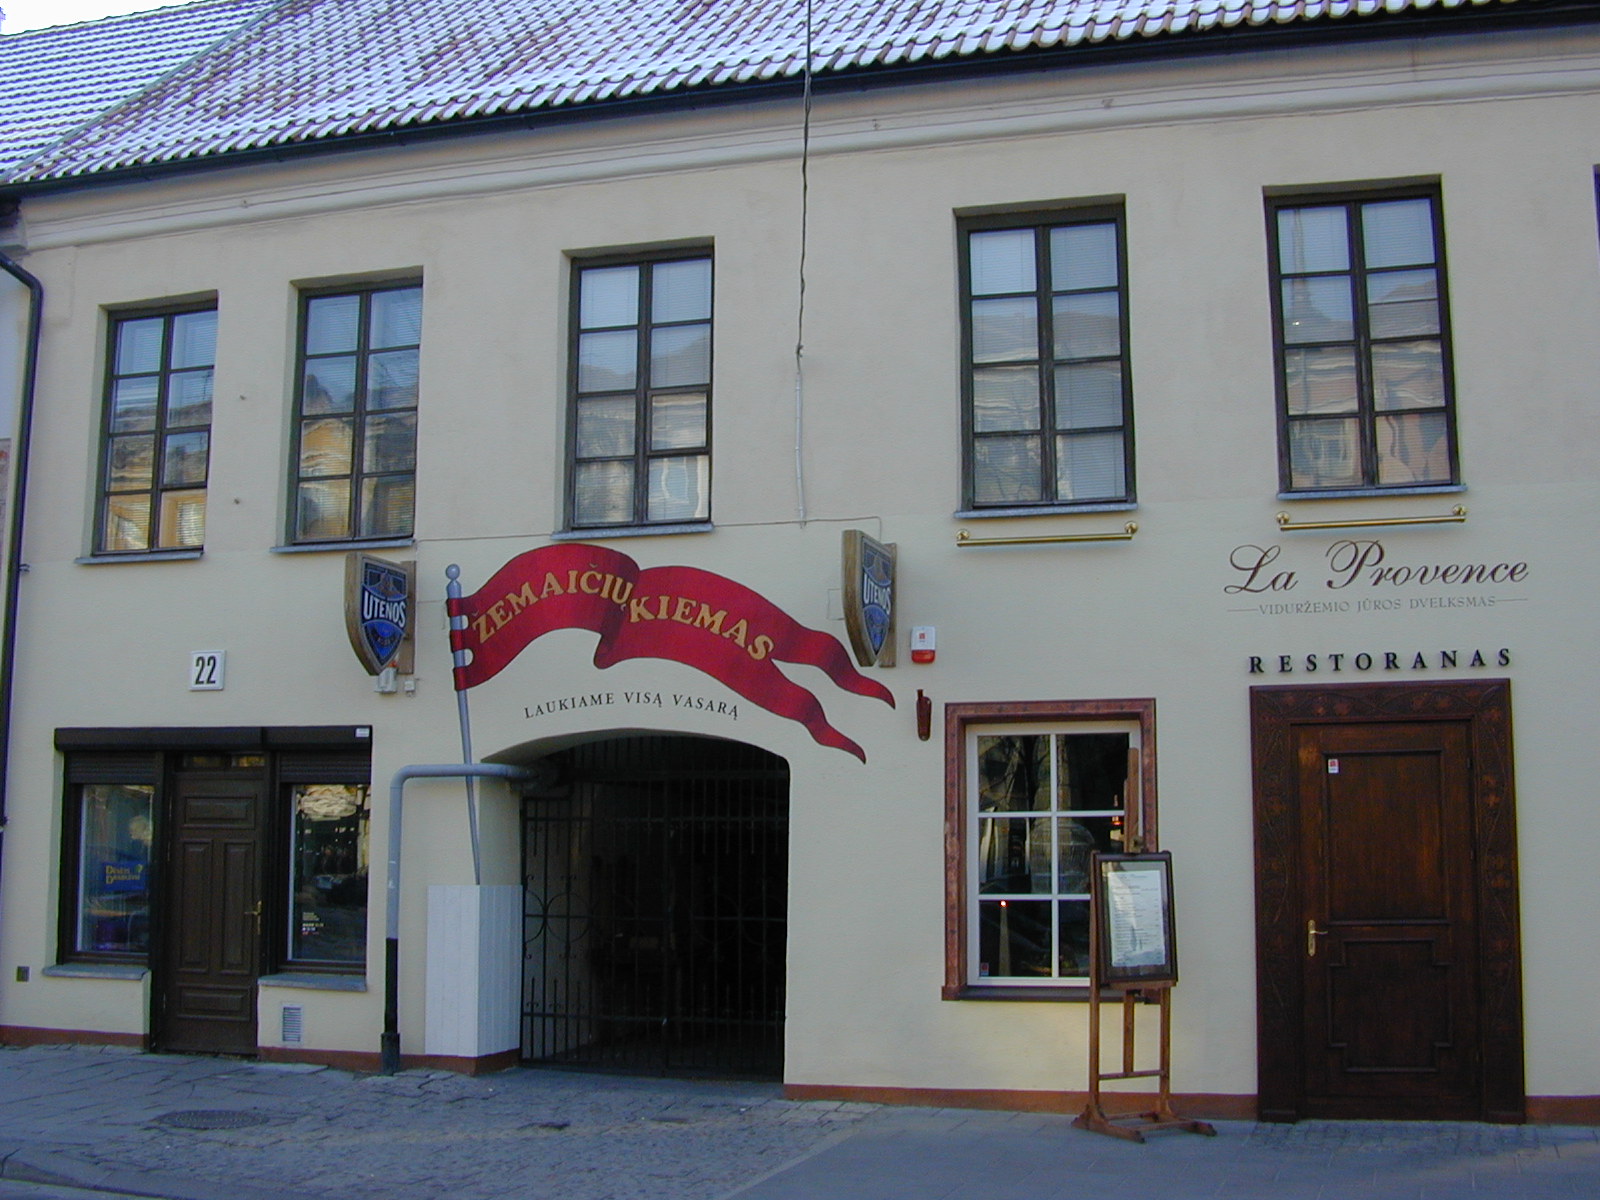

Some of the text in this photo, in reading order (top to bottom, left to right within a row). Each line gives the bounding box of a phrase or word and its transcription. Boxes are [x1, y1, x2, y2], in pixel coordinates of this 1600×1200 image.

[1224, 539, 1529, 594] La Provence
[363, 589, 406, 629] UTENOS
[472, 562, 775, 660] ŽEMAIČIŲ KIEMAS
[863, 573, 891, 616] UTENOS
[1259, 601, 1350, 615] VIDURŽEMIO
[1410, 596, 1496, 609] DVELKSMAS
[195, 655, 217, 685] 22
[1249, 648, 1511, 674] RESTORANAS
[524, 691, 739, 721] LAUKIAME VISĄ VASARĄ
